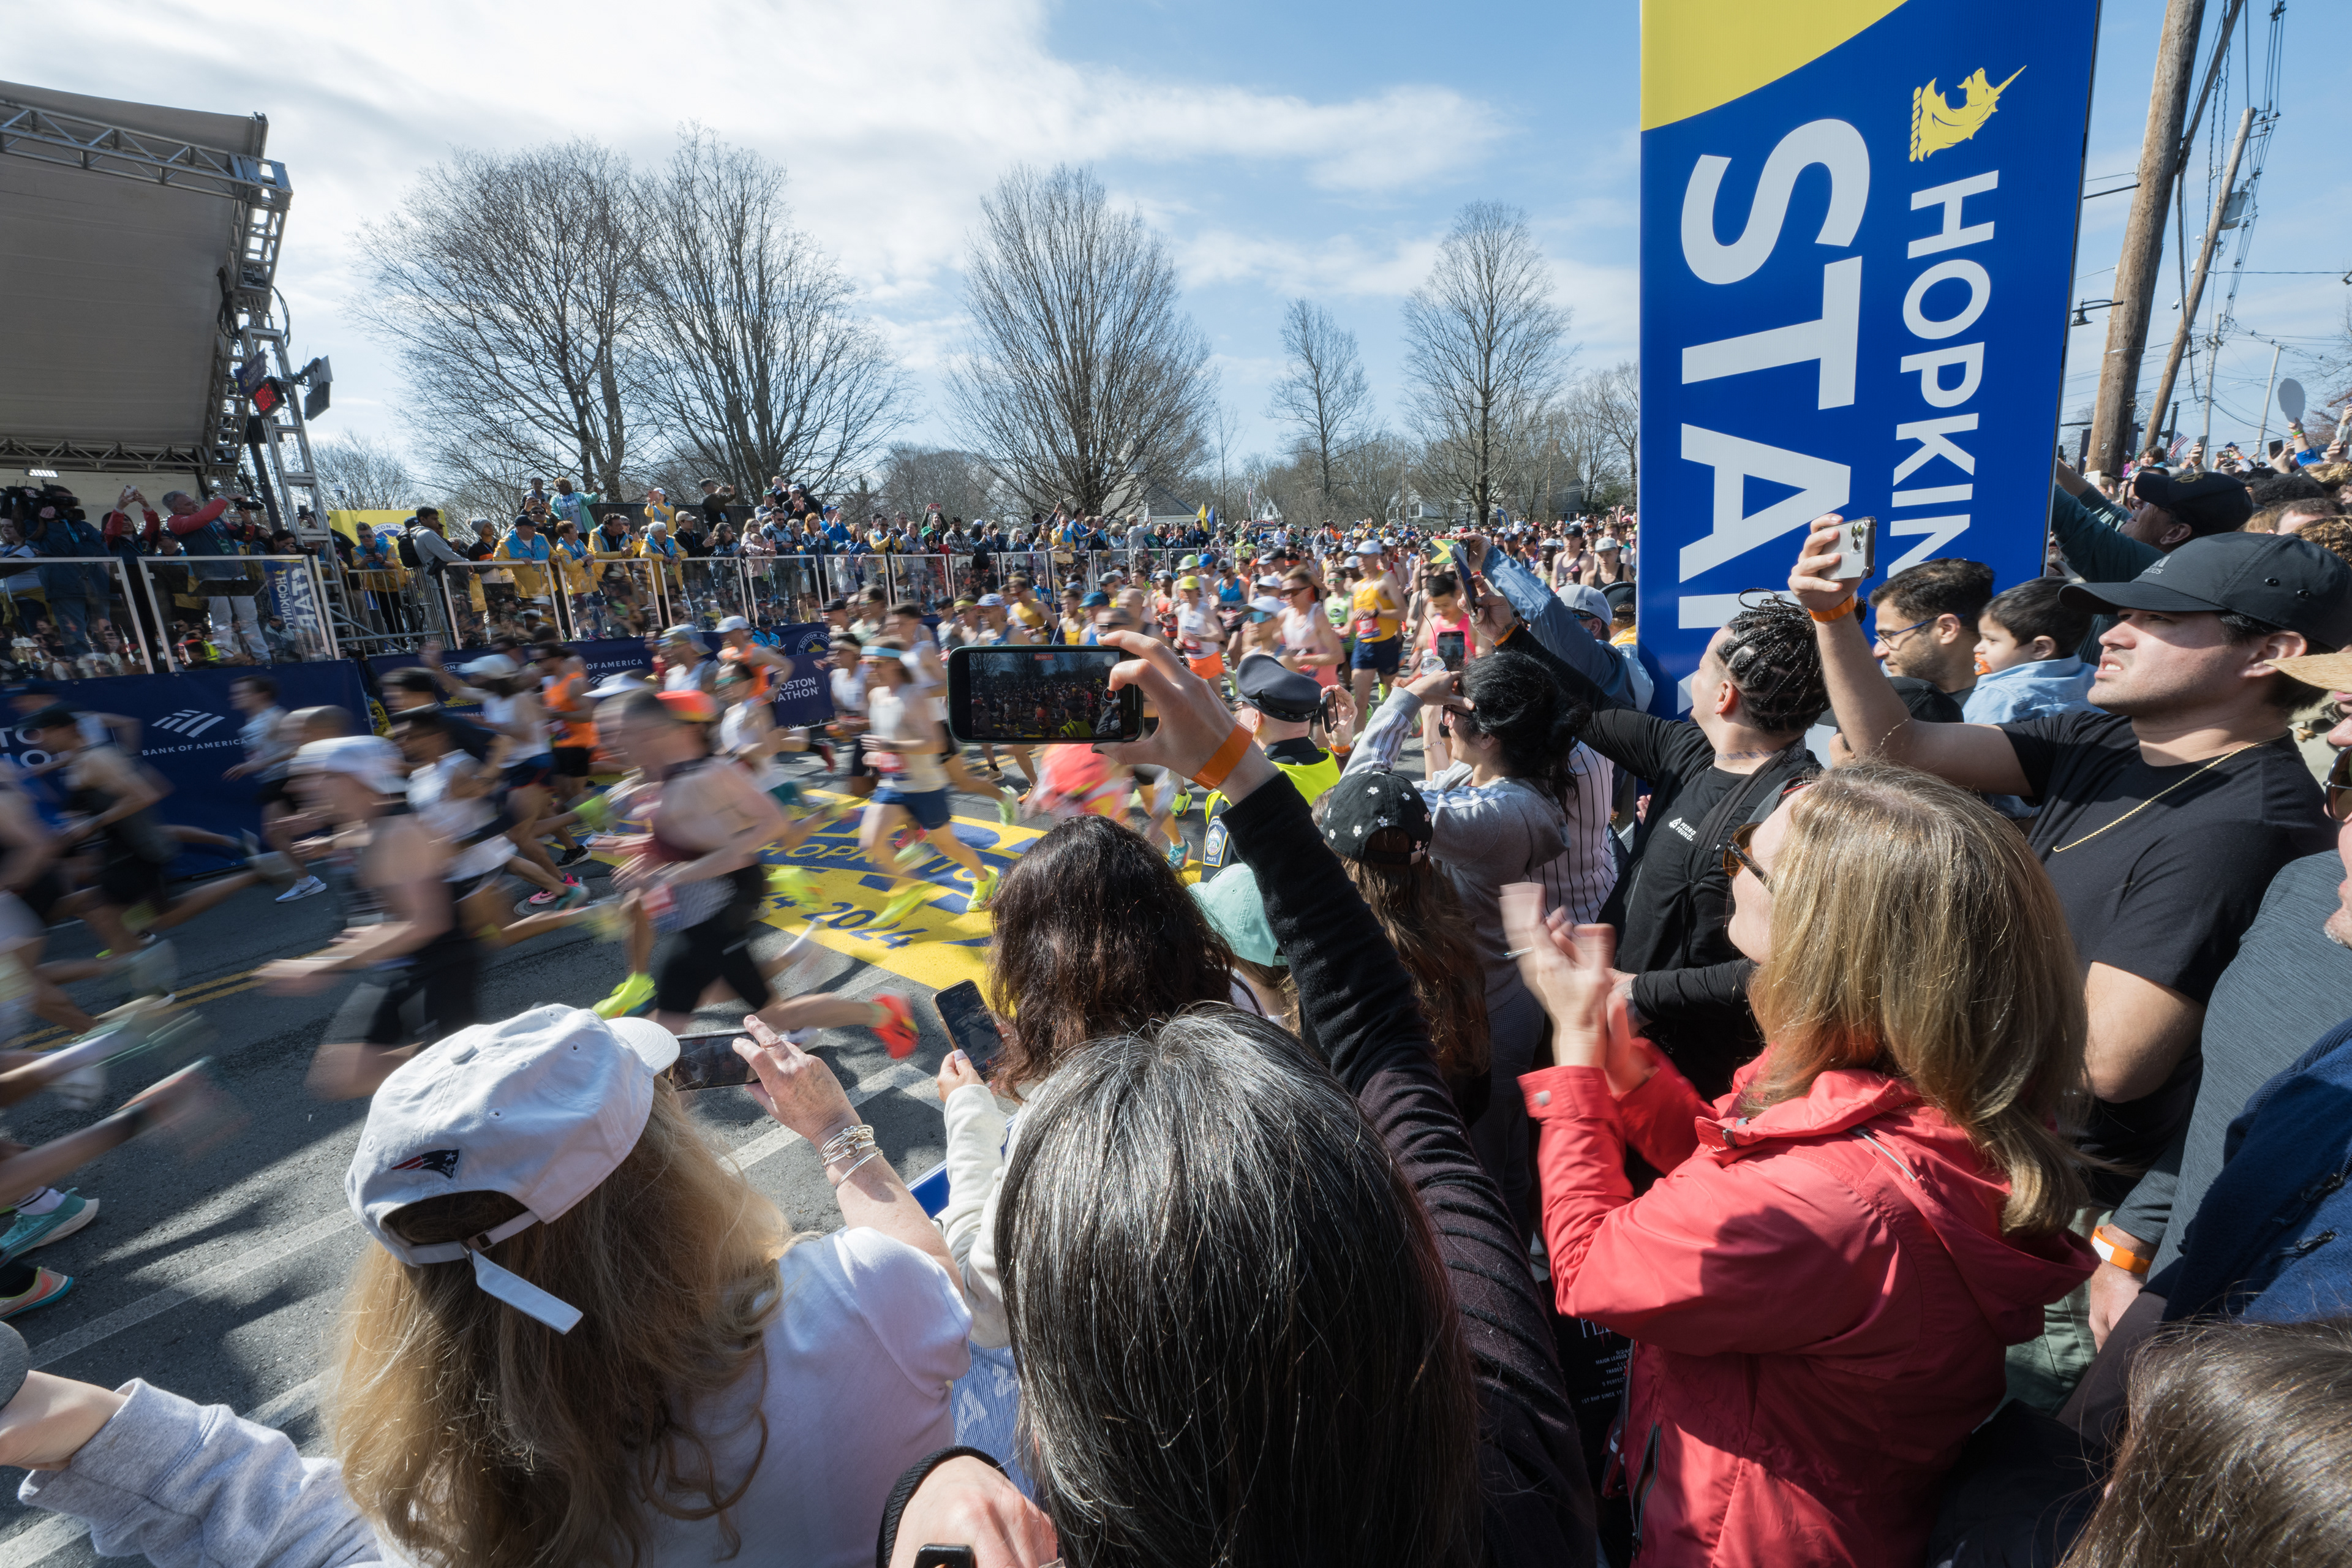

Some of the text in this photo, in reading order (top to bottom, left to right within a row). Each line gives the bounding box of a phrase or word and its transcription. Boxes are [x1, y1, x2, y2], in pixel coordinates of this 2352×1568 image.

[800, 633, 818, 650] BOSTON
[601, 658, 643, 669] AMERICA
[778, 677, 816, 692] OSTON
[142, 747, 176, 756] BANK
[196, 738, 248, 750] AMERICA
[1680, 822, 1697, 836] PEDRO
